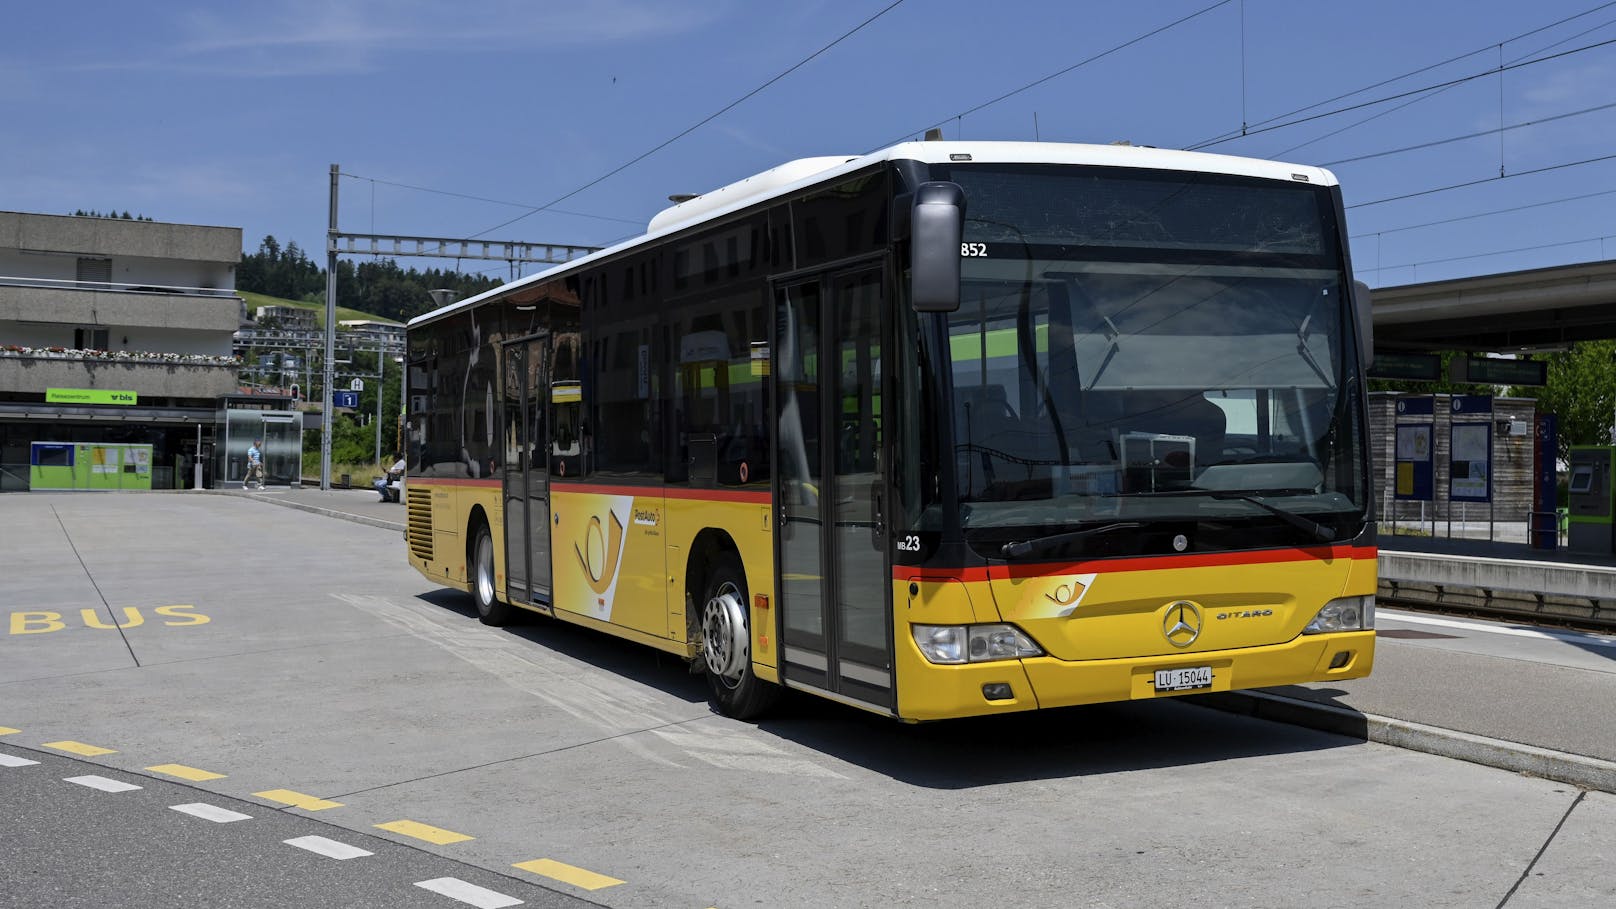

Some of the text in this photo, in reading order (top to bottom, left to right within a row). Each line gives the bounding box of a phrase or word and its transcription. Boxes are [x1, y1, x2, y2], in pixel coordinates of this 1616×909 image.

[961, 242, 988, 257] 852
[347, 396, 352, 405] 1
[9, 604, 211, 635] BUS
[1179, 669, 1208, 684] 15044
